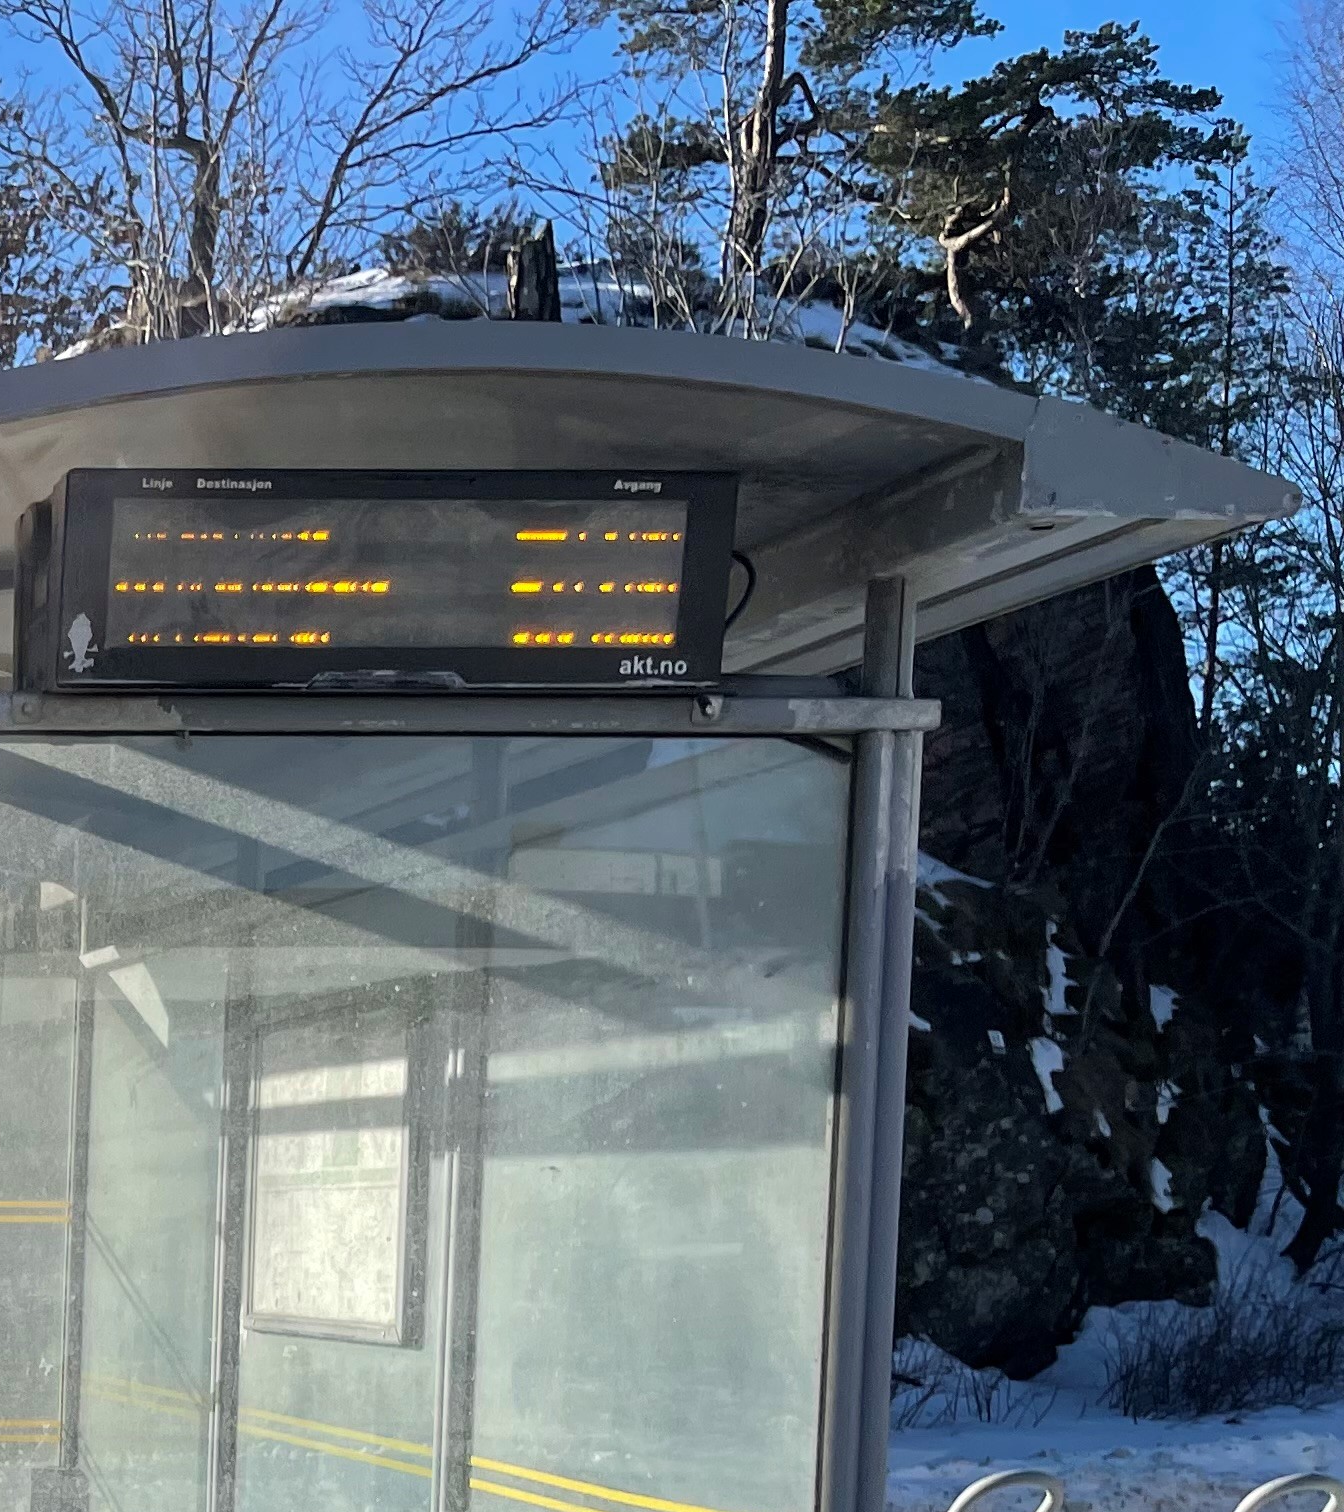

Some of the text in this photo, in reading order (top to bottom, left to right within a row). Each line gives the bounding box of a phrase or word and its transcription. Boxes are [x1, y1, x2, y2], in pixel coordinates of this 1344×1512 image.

[141, 477, 273, 492] Linje Destinasjon
[613, 479, 662, 493] Avgang
[618, 654, 688, 676] akt.no
